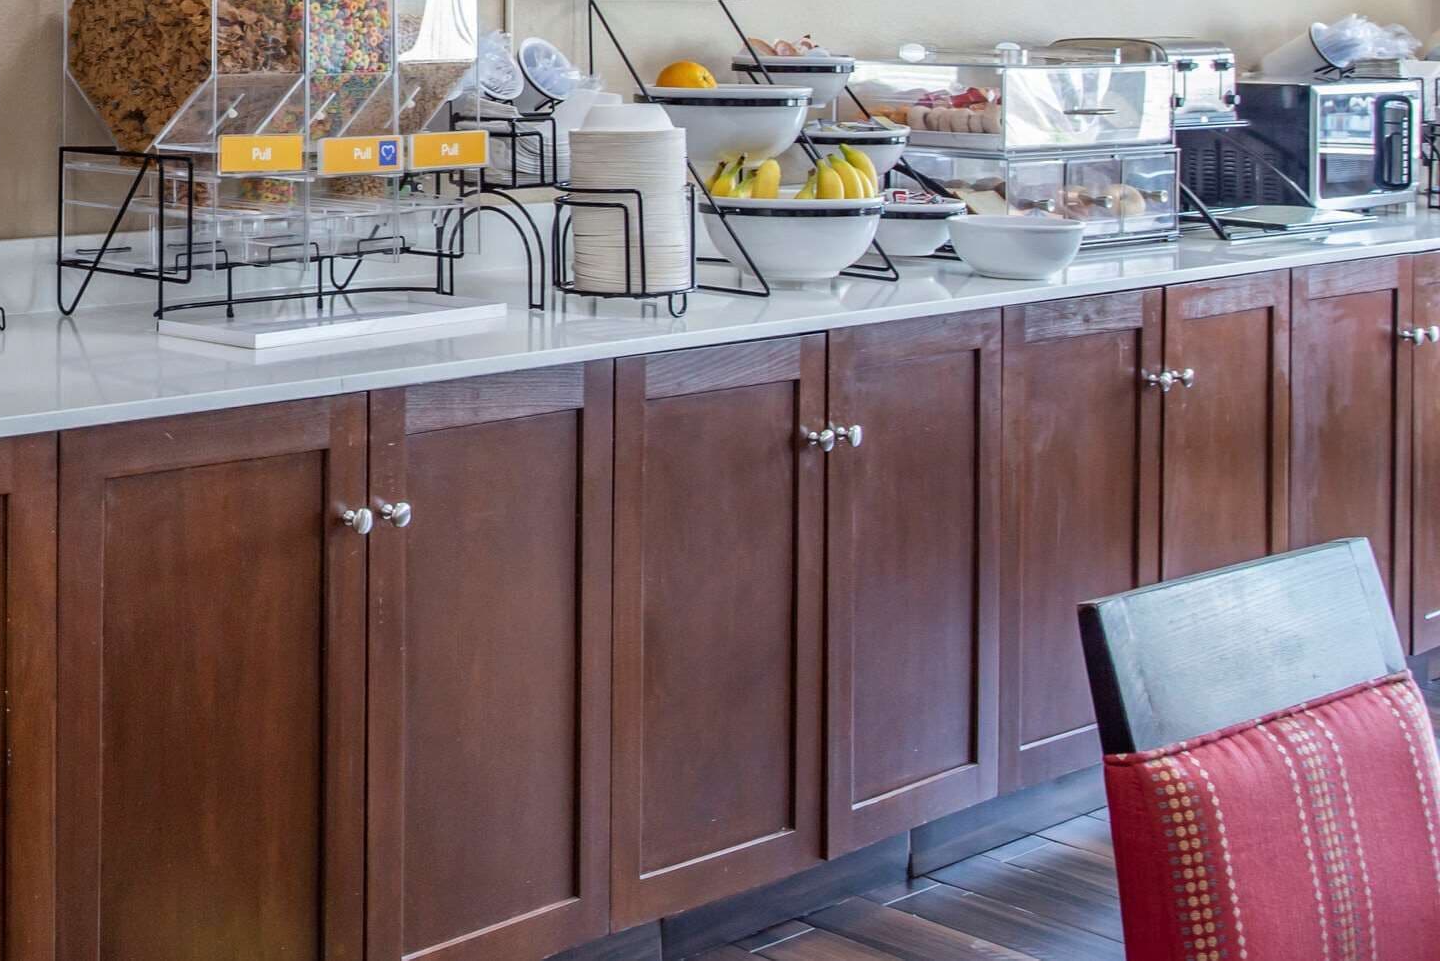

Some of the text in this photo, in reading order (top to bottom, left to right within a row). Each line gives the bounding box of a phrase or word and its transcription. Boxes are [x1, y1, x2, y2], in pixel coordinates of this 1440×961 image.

[252, 147, 272, 161] Pull
[354, 147, 372, 160] Pull
[441, 143, 459, 156] Pull
